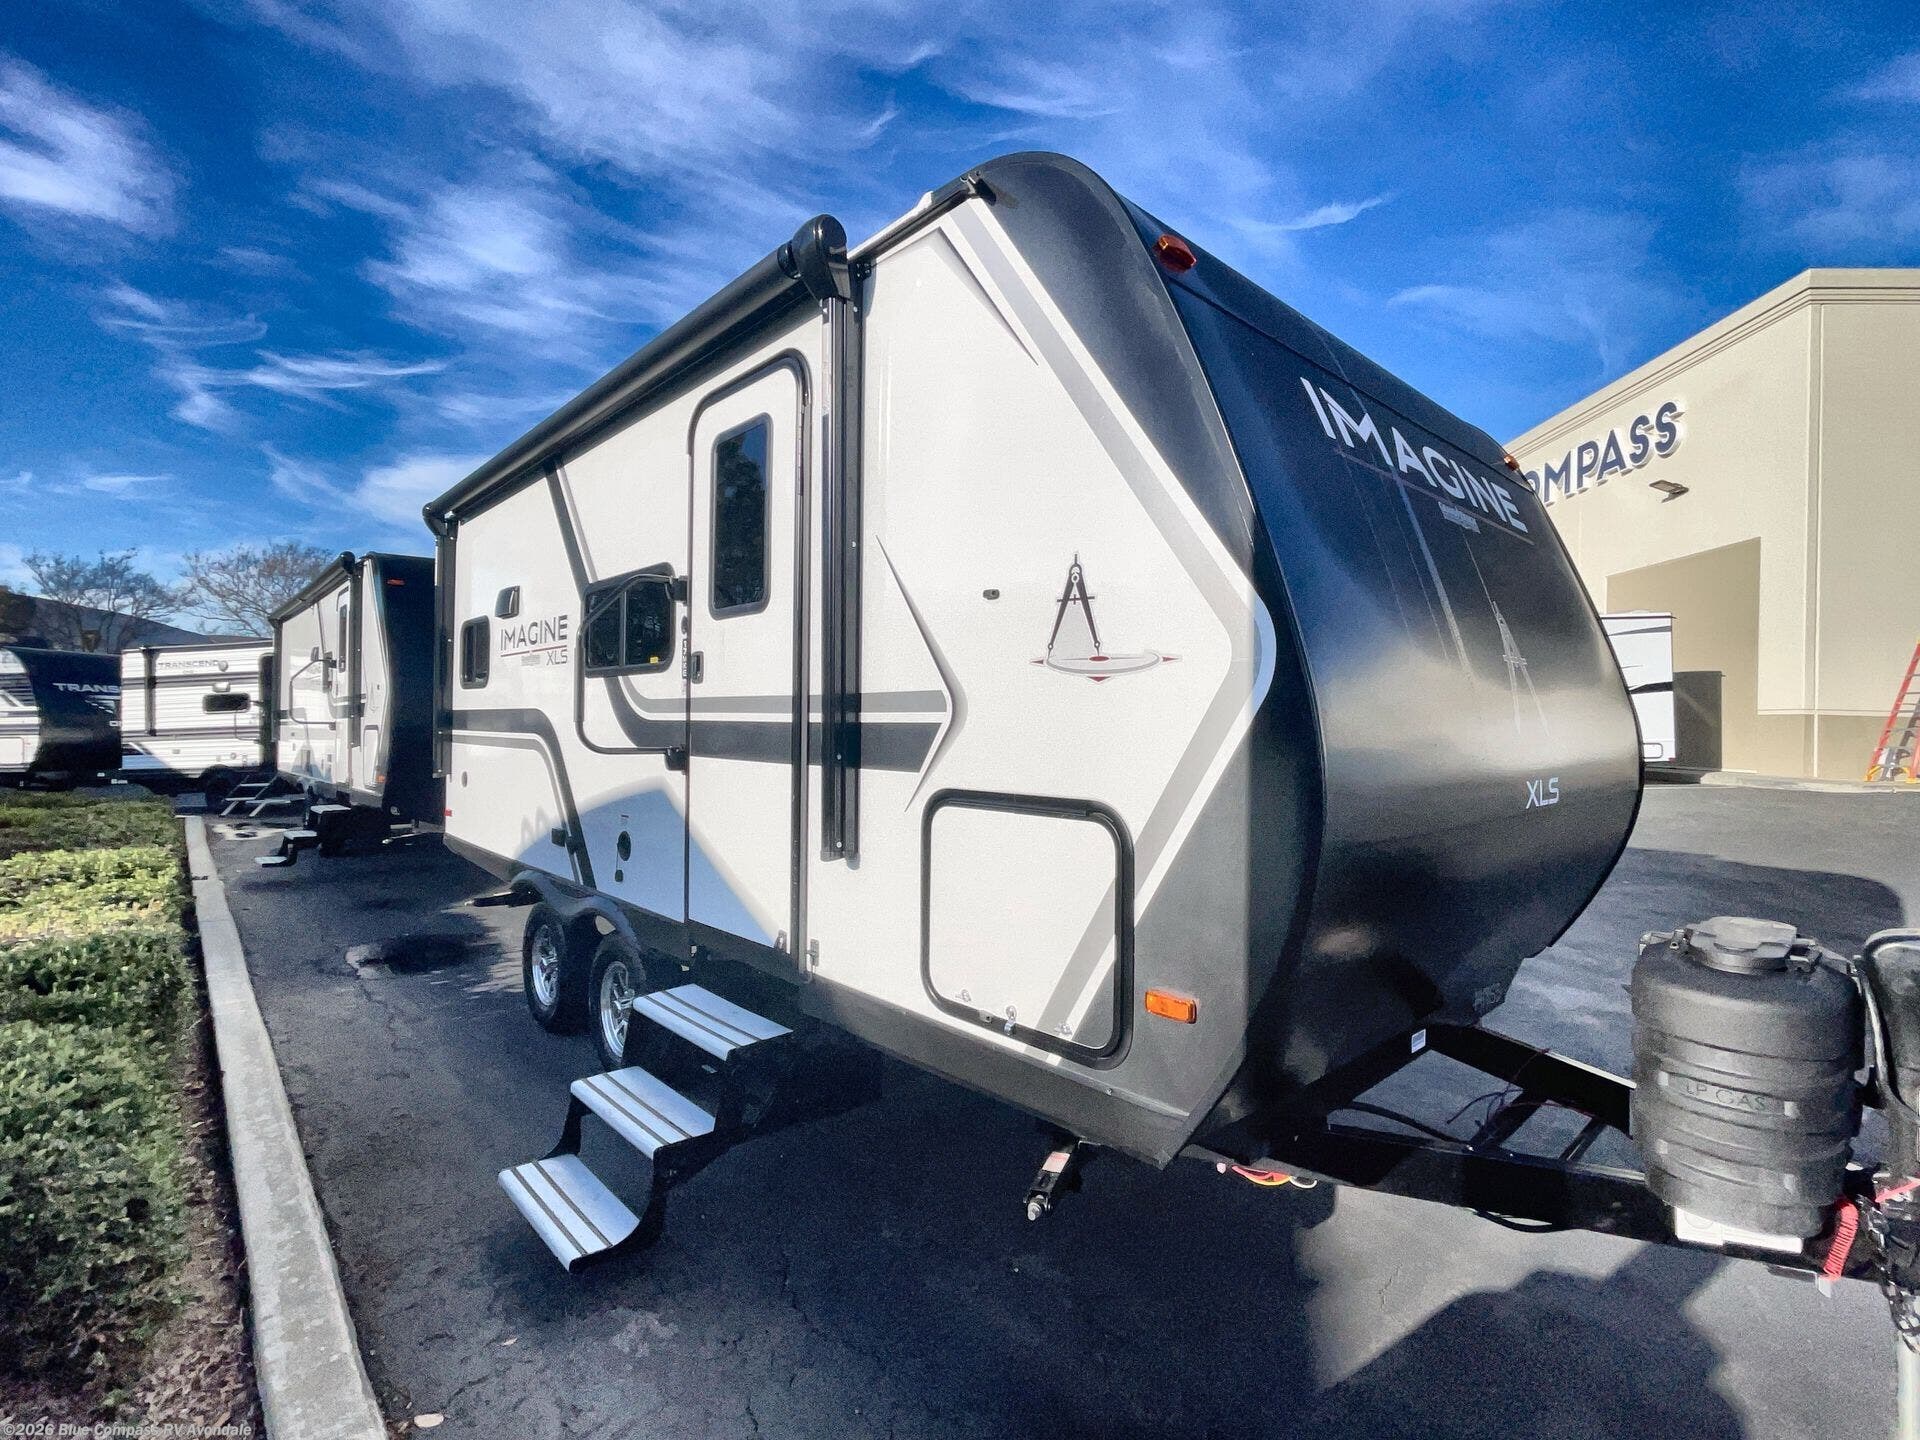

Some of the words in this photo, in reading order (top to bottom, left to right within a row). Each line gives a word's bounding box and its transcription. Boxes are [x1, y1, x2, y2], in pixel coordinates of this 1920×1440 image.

[1300, 377, 1528, 533] IMAGINE
[500, 614, 568, 651] IMAGINE
[546, 649, 568, 666] XLS
[53, 682, 121, 693] TRANS
[1525, 777, 1560, 809] XLS
[1686, 1080, 1707, 1097] LP
[1715, 1089, 1766, 1111] GAS
